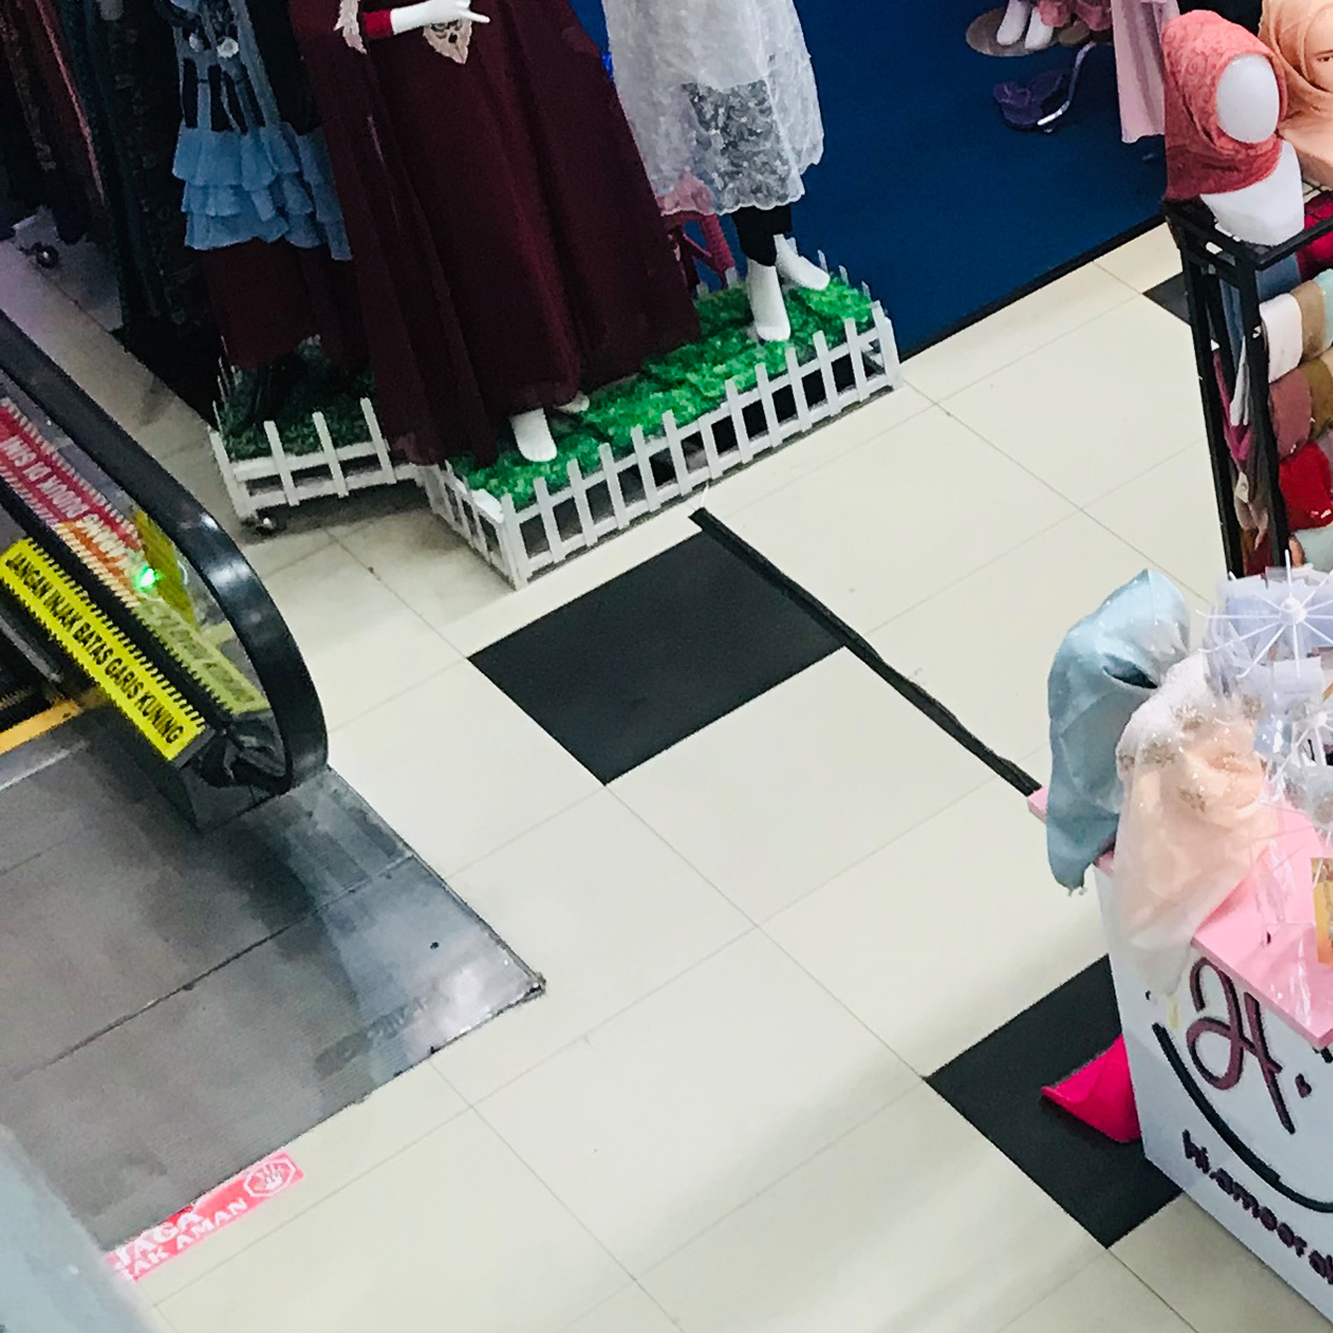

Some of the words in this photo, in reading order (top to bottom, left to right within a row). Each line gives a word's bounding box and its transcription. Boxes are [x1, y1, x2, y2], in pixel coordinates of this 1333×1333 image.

[71, 621, 115, 666] BATAS
[102, 655, 146, 701] GARIS
[133, 690, 186, 745] KUNING
[114, 1212, 203, 1266] JAGA
[176, 1197, 248, 1251] AMAN
